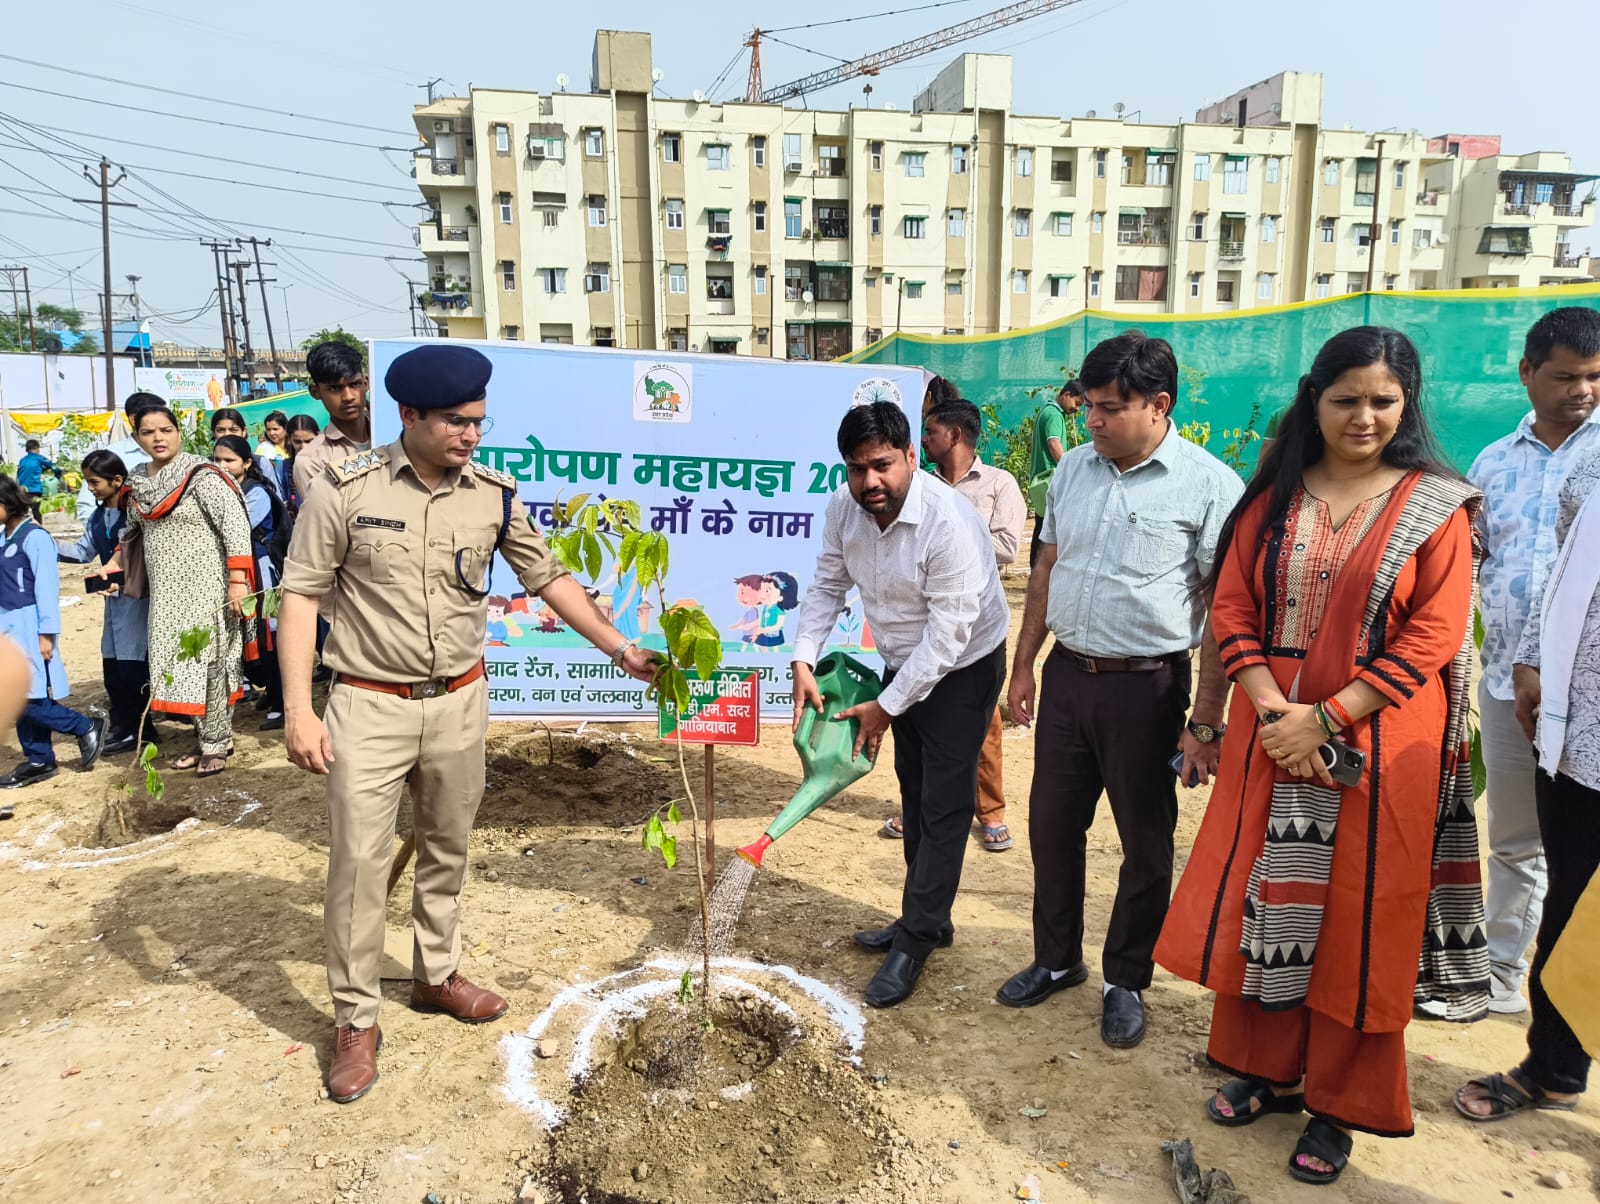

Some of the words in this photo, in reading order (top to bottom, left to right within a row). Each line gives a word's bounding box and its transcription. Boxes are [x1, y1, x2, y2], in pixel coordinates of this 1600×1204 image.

[632, 453, 796, 497] महायज्ञ
[807, 462, 848, 494] 20
[649, 495, 694, 535] माँ
[701, 499, 738, 536] के
[748, 510, 814, 539] नाम
[486, 660, 519, 679] बाद
[524, 656, 560, 680] रेंज,
[488, 687, 526, 703] वरण,
[531, 688, 556, 702] वन
[560, 684, 587, 702] एवं
[587, 689, 644, 710] जलवायु
[665, 699, 724, 718] ए.डी.एम.
[726, 704, 751, 718] सदर
